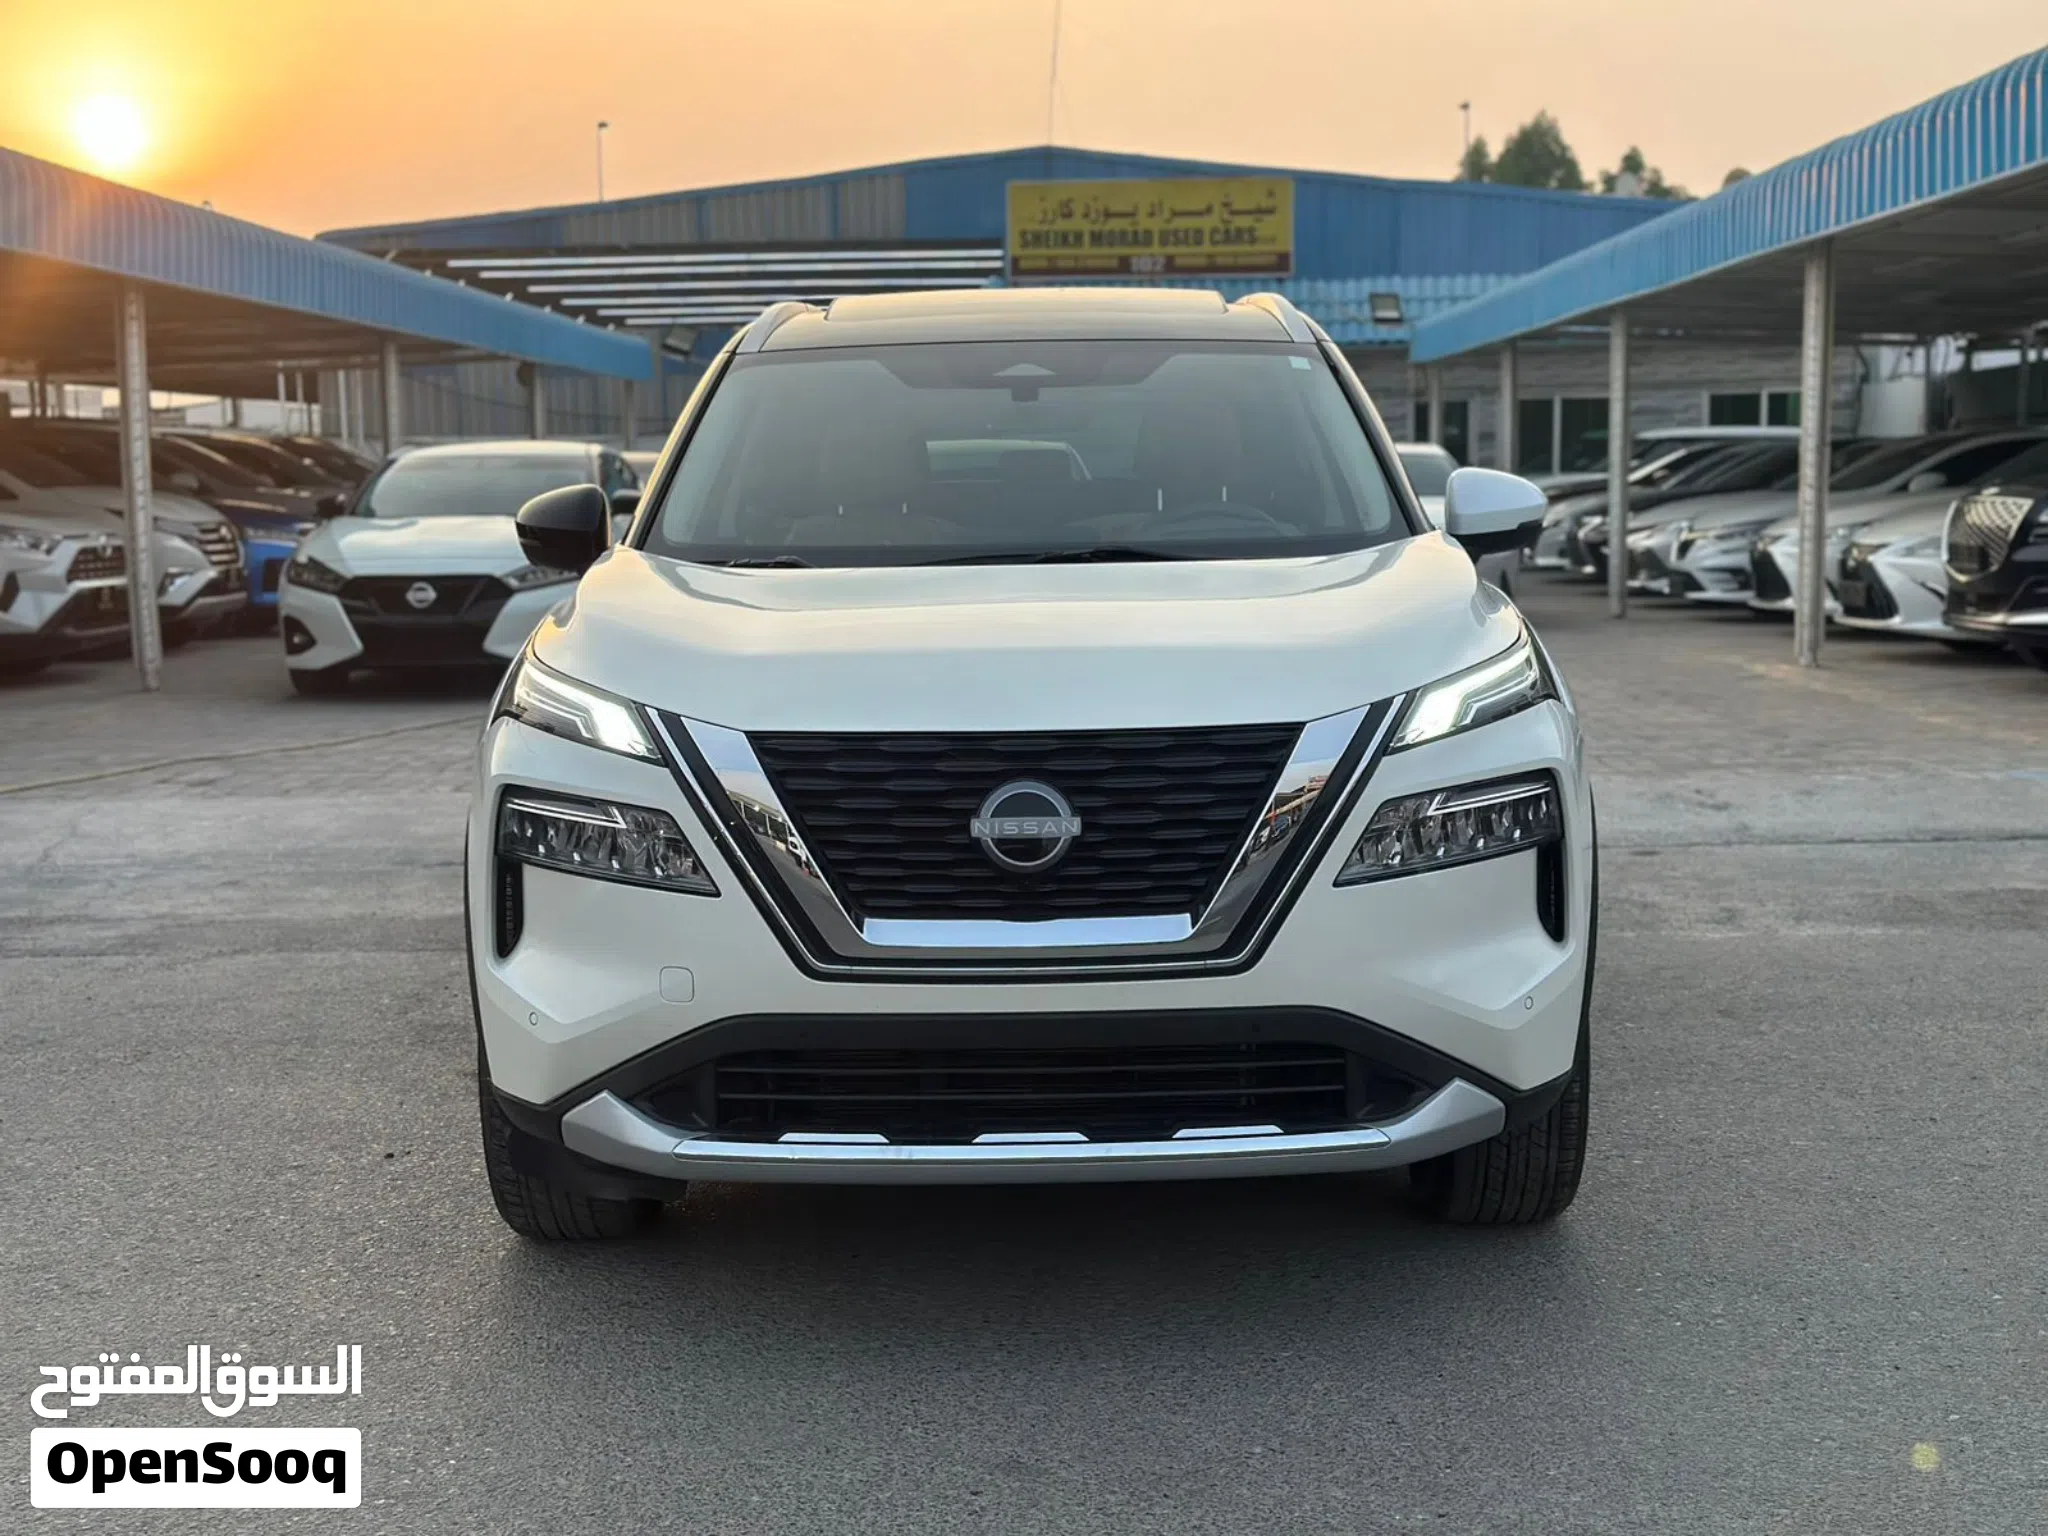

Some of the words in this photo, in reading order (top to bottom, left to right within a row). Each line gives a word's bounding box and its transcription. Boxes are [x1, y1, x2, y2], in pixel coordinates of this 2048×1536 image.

[1145, 199, 1214, 223] مراد
[1219, 187, 1278, 223] شيخ
[1019, 229, 1084, 249] SHEIKH
[1089, 228, 1154, 248] MORAD
[1159, 227, 1205, 247] USED
[1209, 225, 1258, 247] CARS
[973, 820, 1079, 835] NISSAN
